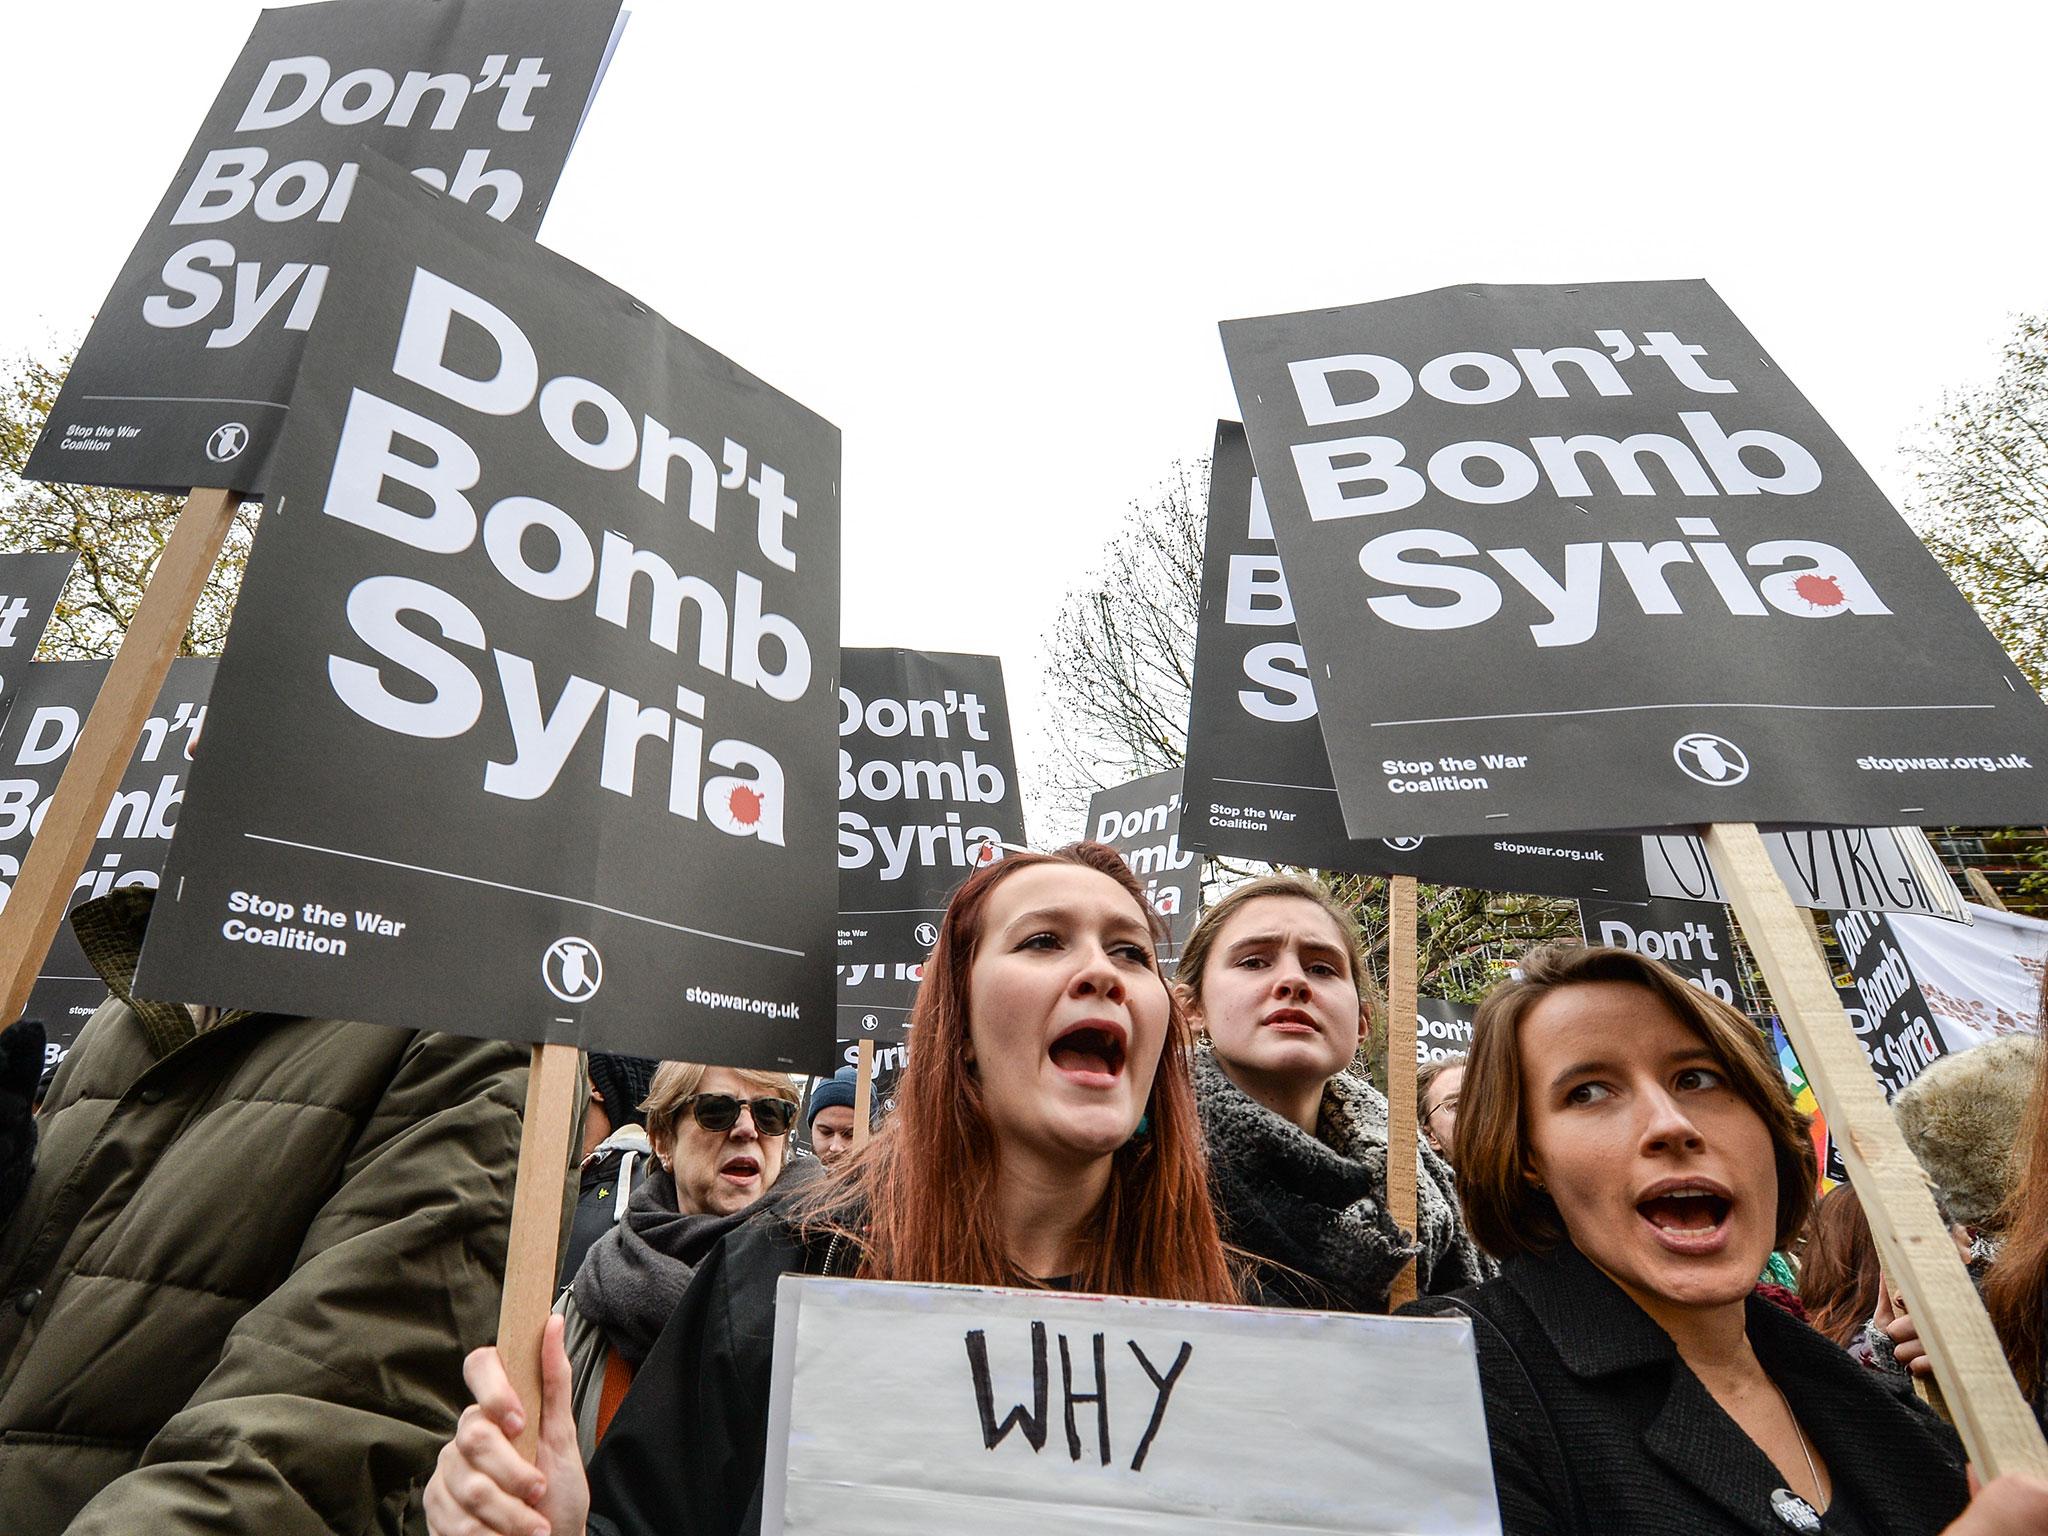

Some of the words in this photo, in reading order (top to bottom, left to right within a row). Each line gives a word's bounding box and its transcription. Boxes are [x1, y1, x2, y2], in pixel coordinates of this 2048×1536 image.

[234, 54, 551, 132] Don't
[1287, 329, 1738, 426] Don't
[65, 424, 93, 438] Stop
[93, 425, 115, 437] the
[116, 425, 142, 438] War
[392, 265, 798, 573] Don't
[60, 438, 112, 451] Coalition
[1290, 411, 1822, 521] Bomb
[323, 387, 812, 702] Bomb
[1358, 517, 1894, 648] Syria
[327, 575, 786, 848] Syria
[1382, 759, 1435, 776] Stop
[1438, 757, 1478, 772] the
[1480, 754, 1528, 770] War
[1387, 775, 1489, 794] Coalition
[1856, 753, 2034, 774] stopwar.org.uk
[1209, 803, 1241, 817] Stop
[1243, 807, 1267, 819] the
[1269, 809, 1297, 821] War
[1209, 816, 1268, 831] Coalition
[1493, 841, 1605, 861] stopwar.org.uk
[227, 890, 295, 924] Stop
[302, 903, 348, 929] the
[354, 910, 407, 938] War
[222, 919, 348, 957] Coalition
[686, 986, 800, 1021] stopwar.org.uk
[1857, 939, 1911, 1031] Bomb
[964, 1320, 1193, 1472] WHY
